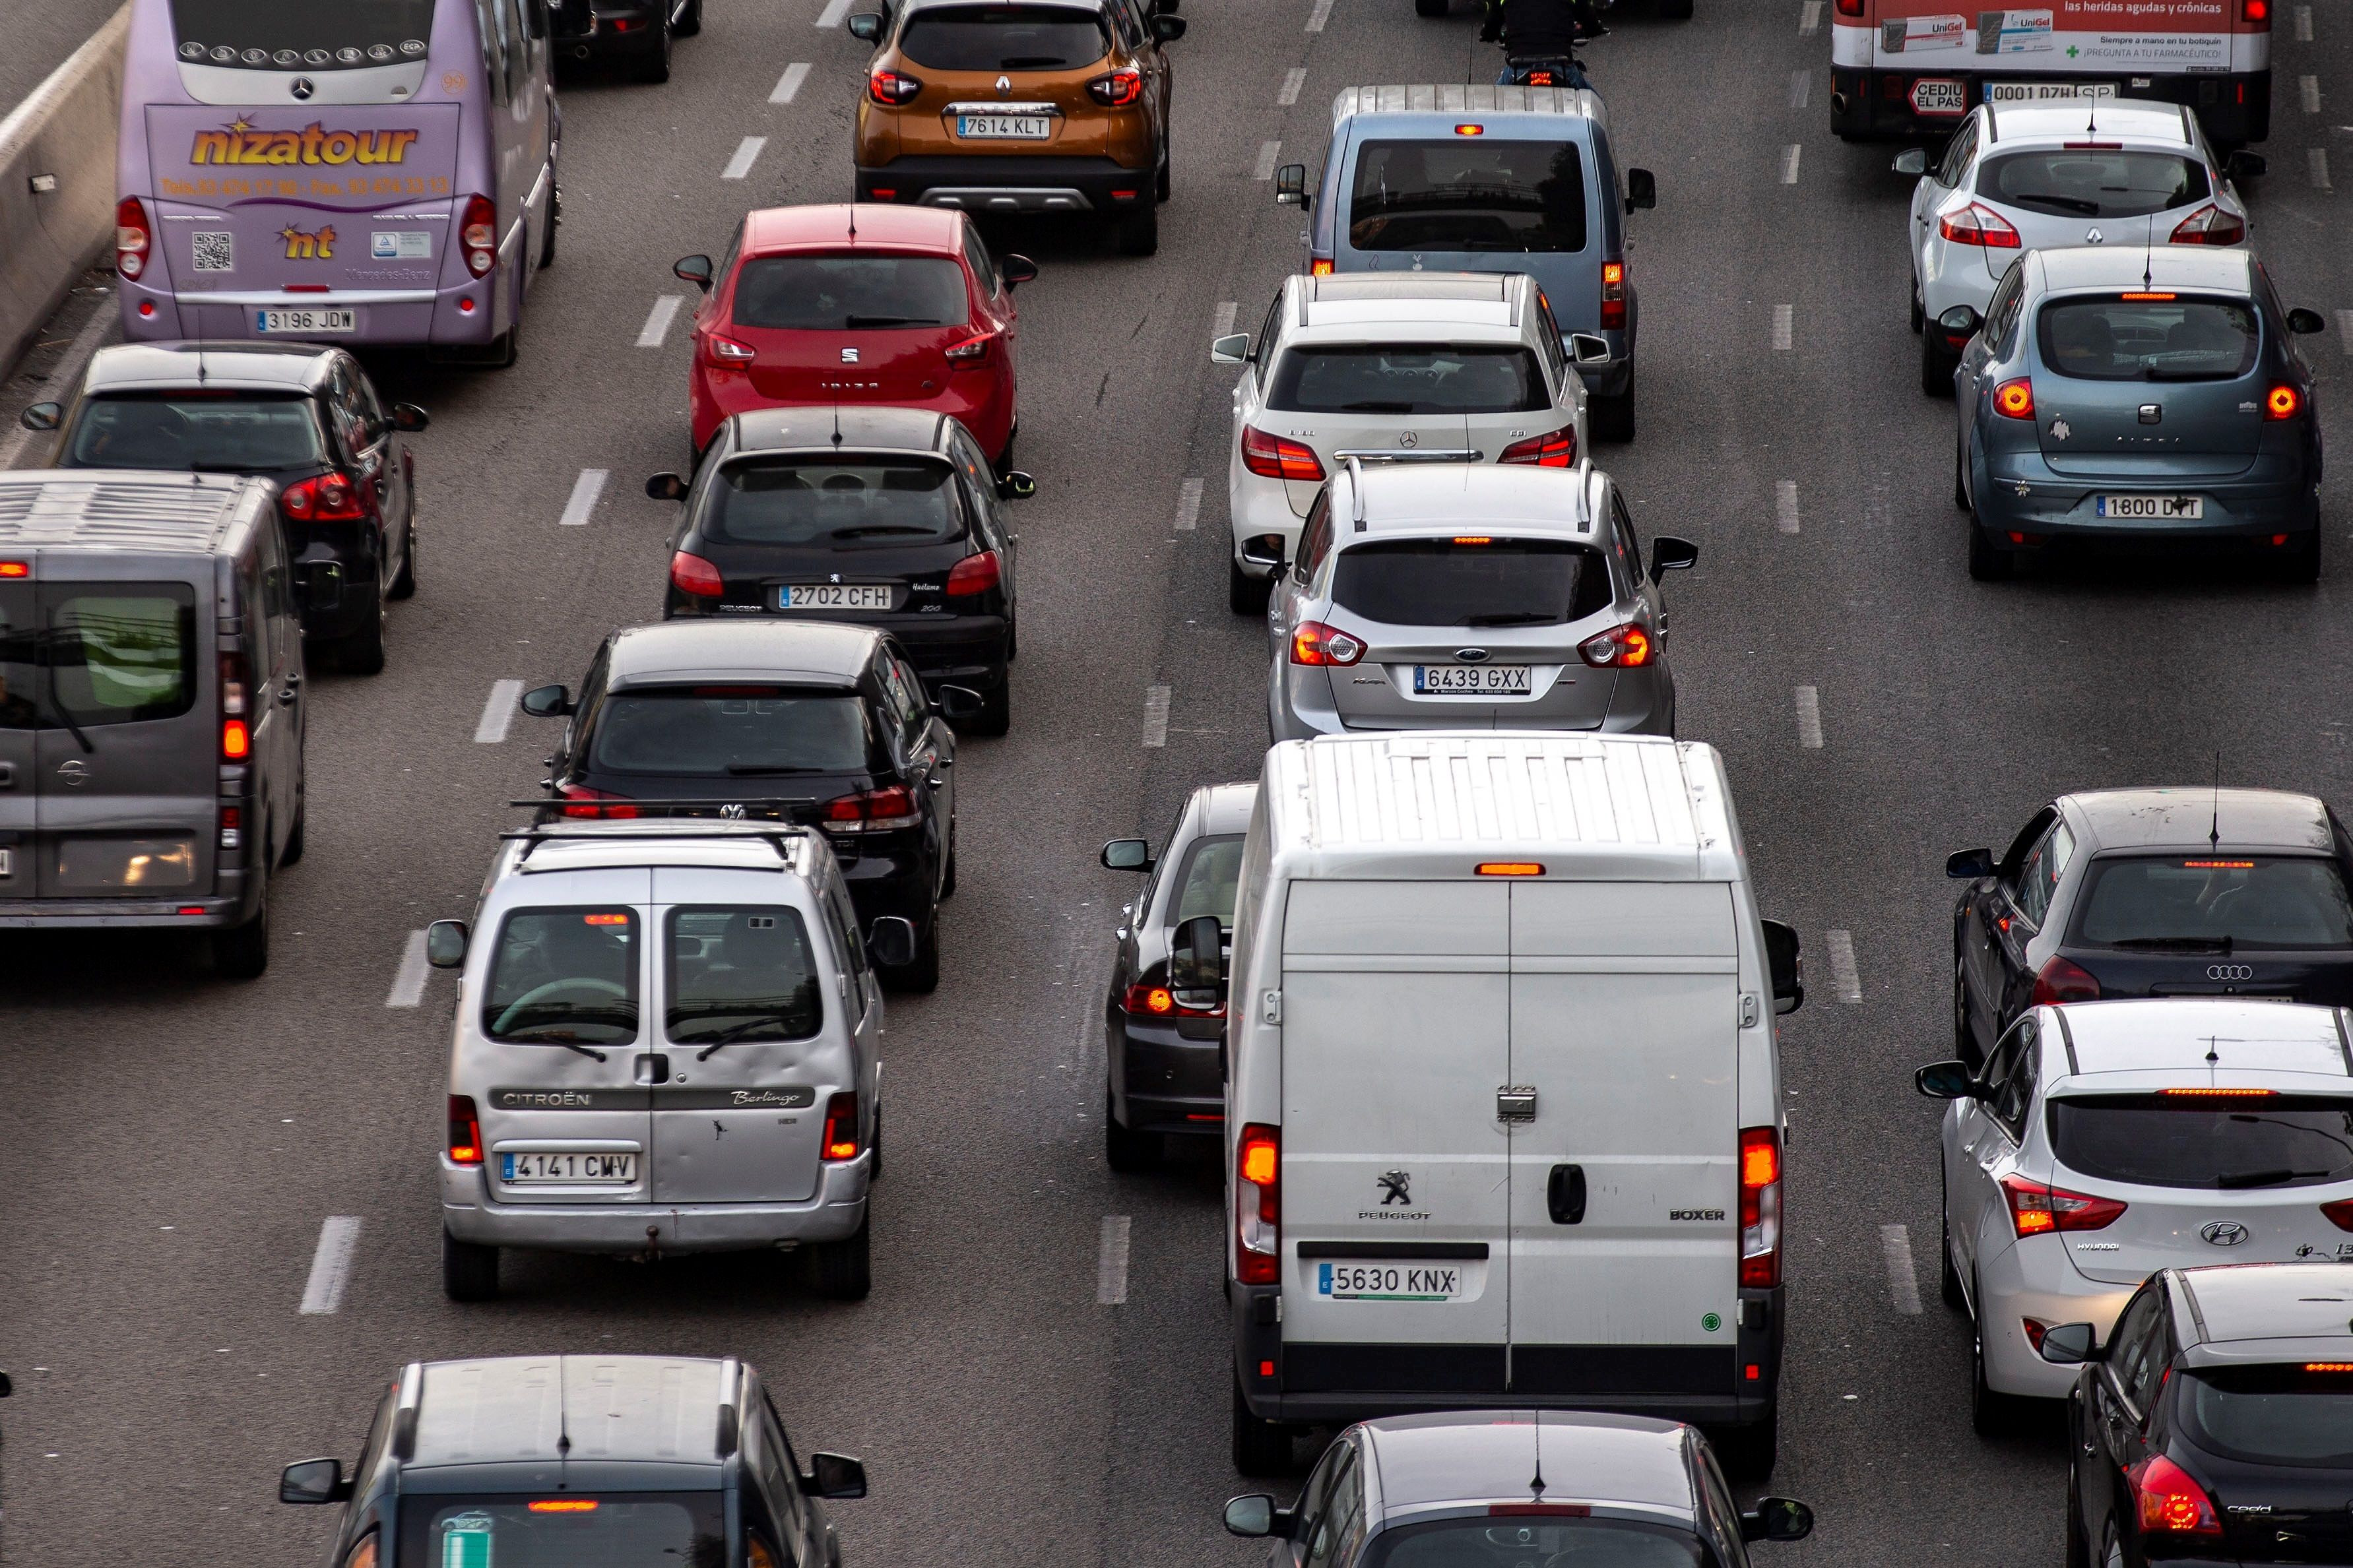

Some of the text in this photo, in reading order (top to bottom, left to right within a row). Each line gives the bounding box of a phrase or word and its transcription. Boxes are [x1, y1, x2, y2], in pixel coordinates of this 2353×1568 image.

[2064, 1, 2222, 15] las heridas agudas y crónicas
[1932, 22, 1962, 33] UniGel
[2020, 18, 2049, 27] UniGel
[2100, 36, 2133, 45] Siempre
[2189, 37, 2222, 47] botiquín
[1917, 84, 1962, 95] CEDIU
[1994, 86, 2033, 100] 0001
[1917, 96, 1963, 108] EL PAS
[968, 119, 1045, 134] 7614 KLT
[190, 117, 419, 165] nizatour
[284, 224, 336, 259] nt
[344, 267, 431, 280] Mercedes-Benz
[268, 311, 351, 329] 3196 JDW
[2111, 499, 2156, 516] 1800
[792, 586, 842, 605] 2702
[849, 587, 886, 606] CFH
[1428, 669, 1480, 688] 6439
[1487, 670, 1526, 688] GXX
[502, 1091, 591, 1107] CITROËN
[730, 1090, 800, 1106] Berlingo
[517, 1156, 575, 1177] 4141
[1357, 1210, 1431, 1220] PEUGEOT
[1669, 1208, 1725, 1220] BOXER
[1336, 1267, 1399, 1291] 5630
[1407, 1269, 1454, 1293] KNX
